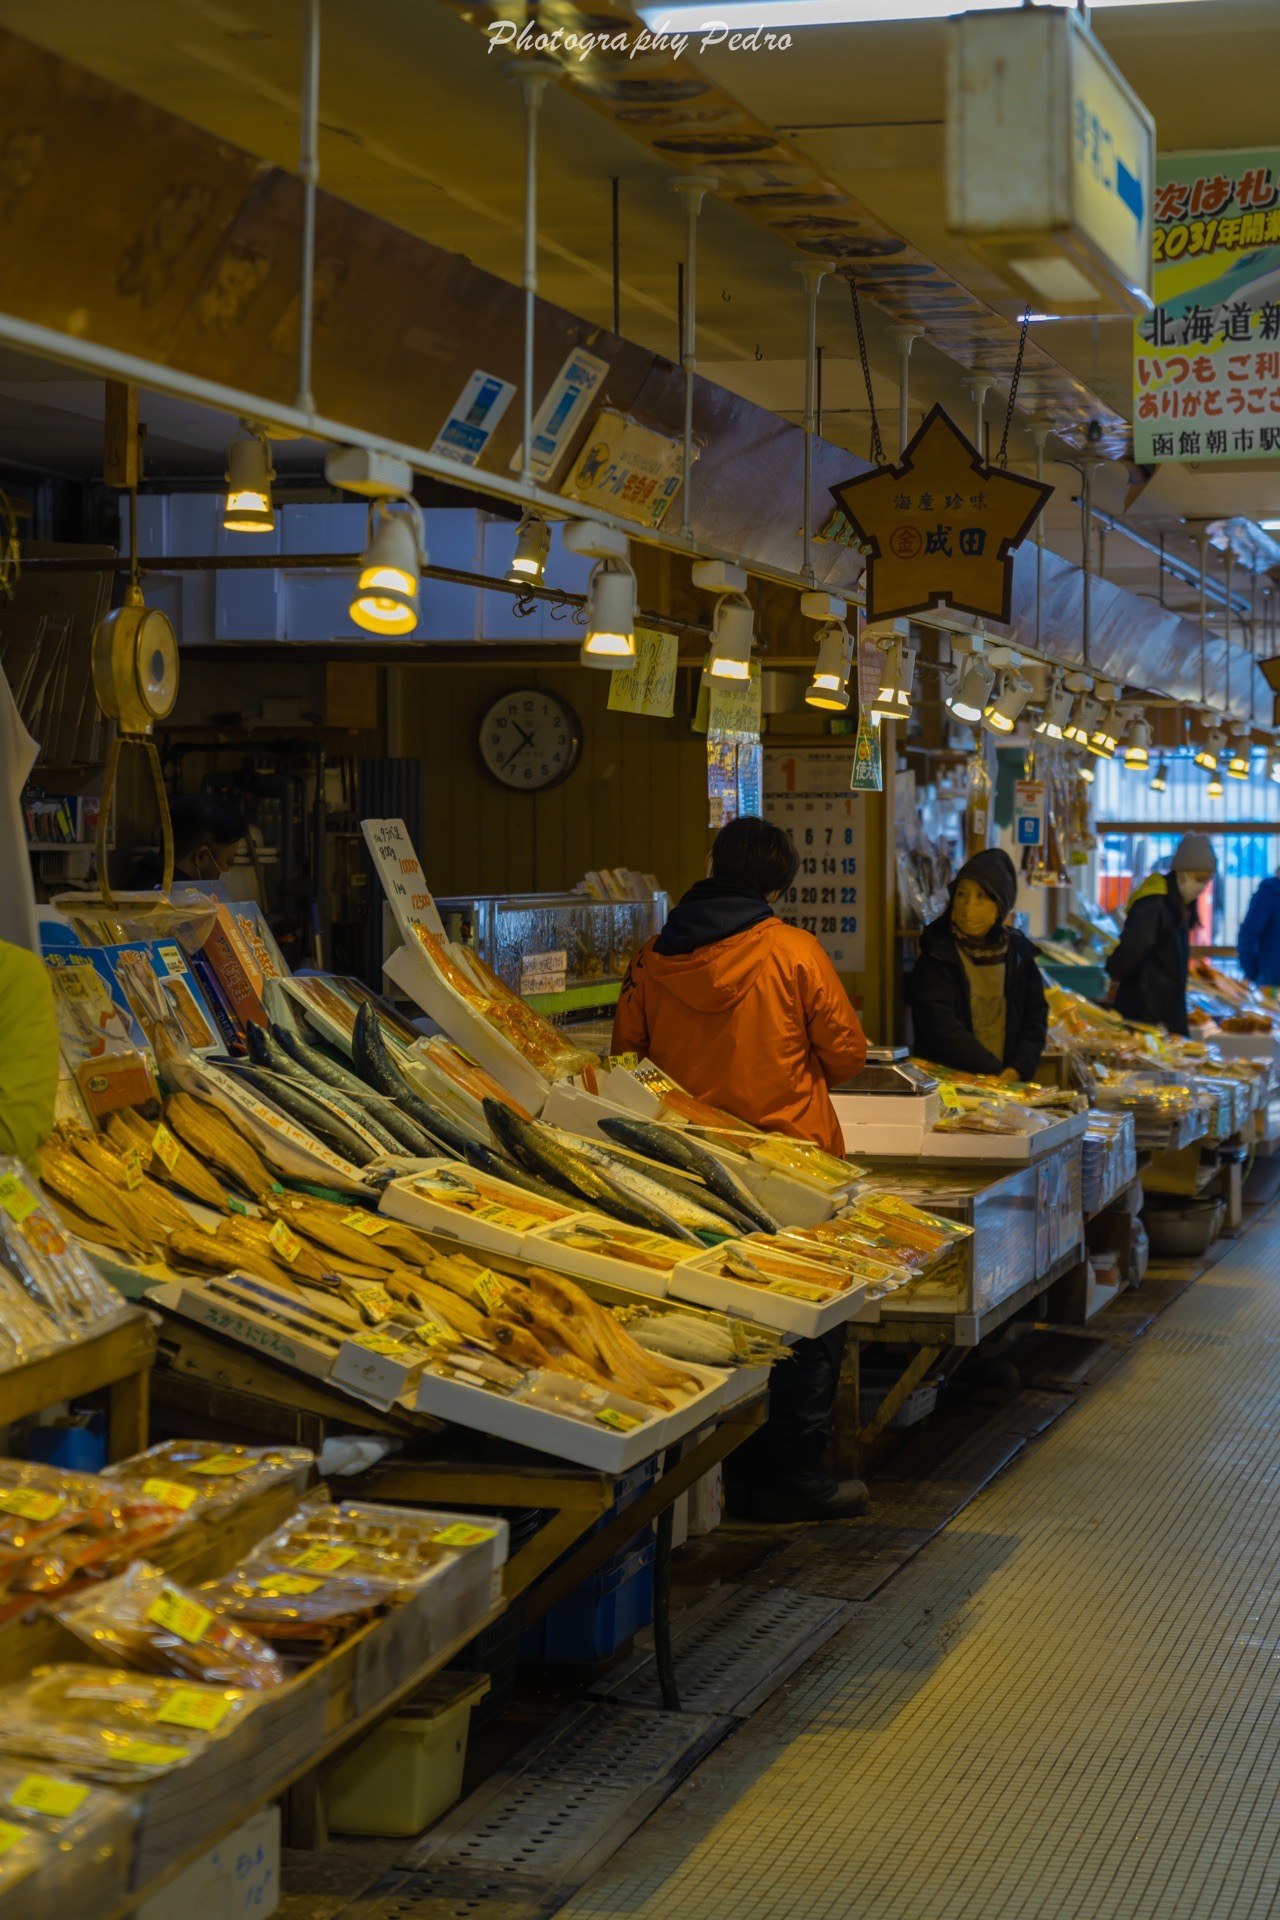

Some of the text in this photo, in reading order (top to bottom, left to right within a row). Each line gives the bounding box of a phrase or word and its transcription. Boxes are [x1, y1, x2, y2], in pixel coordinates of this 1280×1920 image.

[1154, 168, 1280, 221] 次は札
[1145, 301, 1280, 347] 北海道新
[1153, 426, 1280, 457] 函館朝市駅
[893, 492, 988, 512] 海産珍味
[923, 524, 987, 558] 成田
[805, 828, 813, 845] 6
[825, 828, 833, 845] 7
[845, 828, 853, 845] 8
[802, 858, 856, 874] 13 14 15
[801, 887, 817, 903] 20
[821, 887, 836, 903] 21
[841, 887, 856, 903] 22
[802, 917, 817, 933] 27
[821, 917, 837, 933] 28
[841, 917, 856, 933] 29
